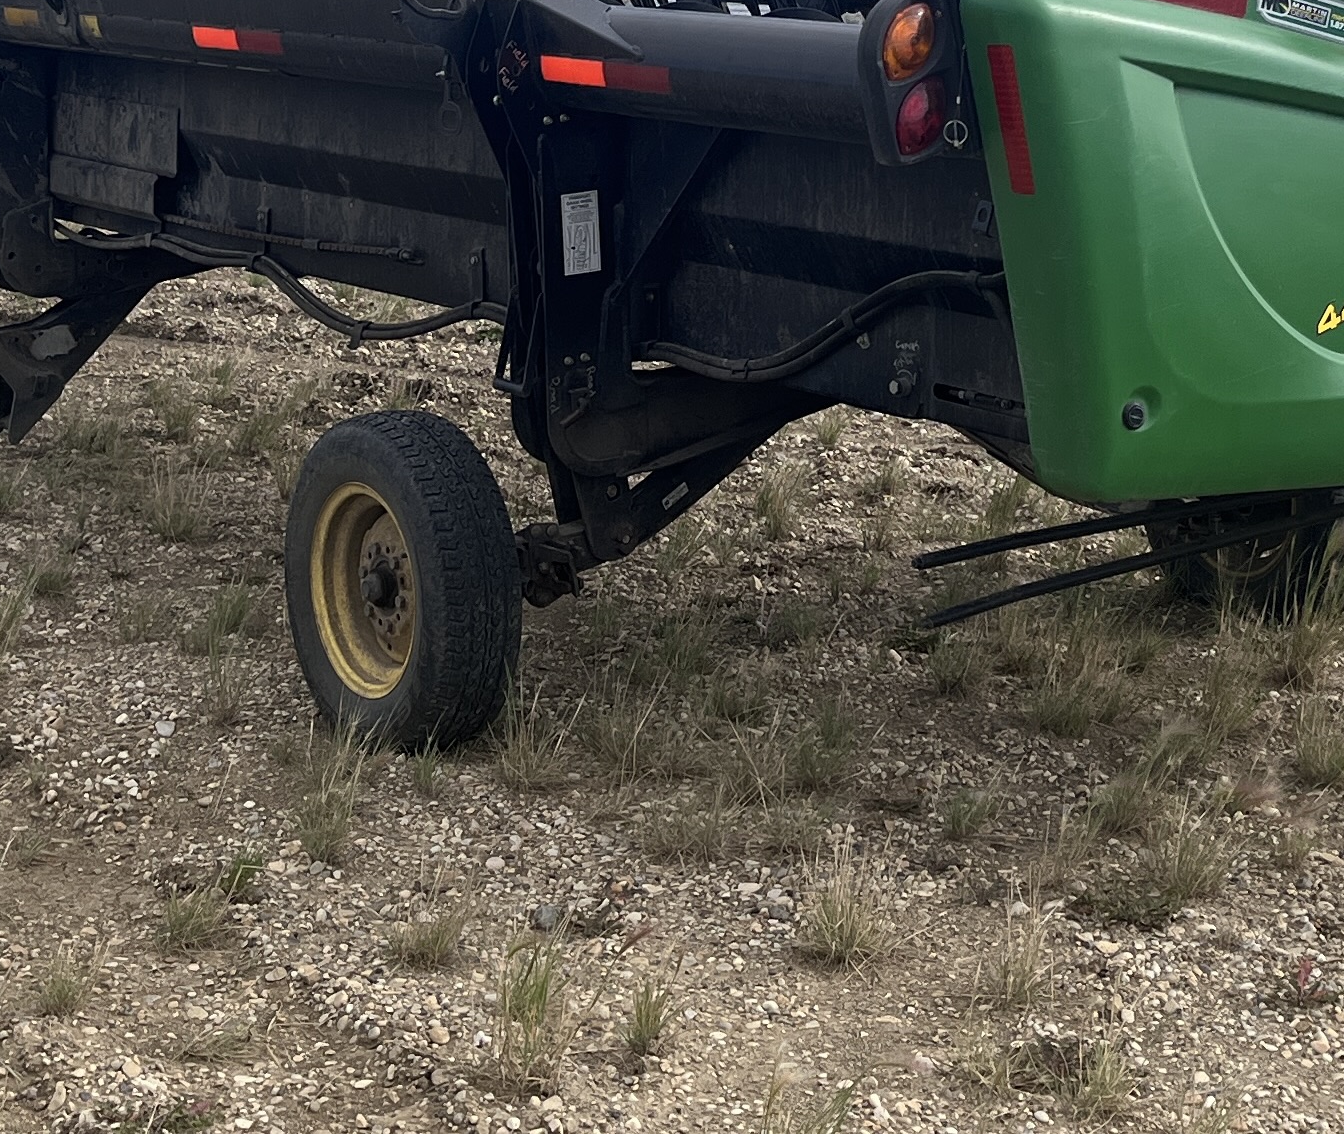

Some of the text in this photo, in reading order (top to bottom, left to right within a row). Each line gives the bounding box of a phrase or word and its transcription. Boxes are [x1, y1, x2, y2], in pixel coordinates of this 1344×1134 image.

[1291, 1, 1329, 17] MARTIN
[506, 40, 529, 71] Field
[499, 66, 519, 95] Field
